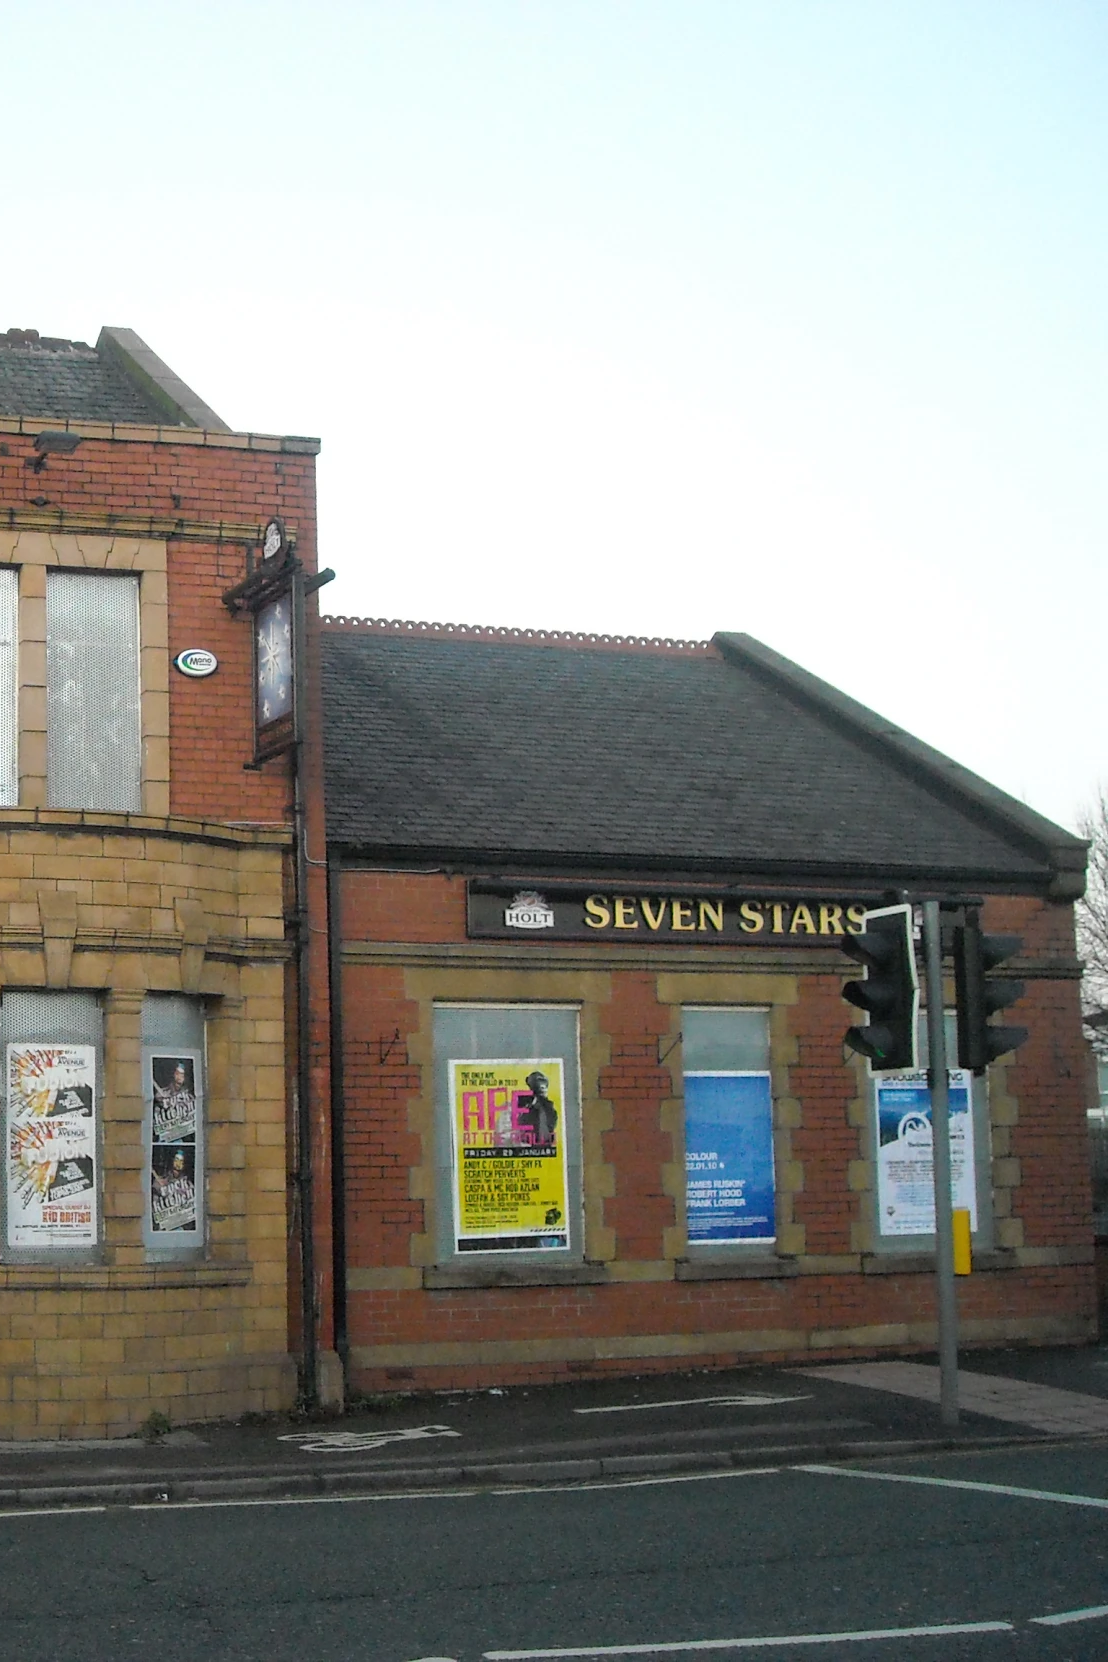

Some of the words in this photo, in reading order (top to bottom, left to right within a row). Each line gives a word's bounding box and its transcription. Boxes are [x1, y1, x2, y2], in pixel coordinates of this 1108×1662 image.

[509, 913, 551, 924] HOLT
[584, 895, 724, 932] SEVEN
[739, 900, 868, 935] STARS
[462, 1087, 534, 1131] APE
[463, 1132, 478, 1146] AT
[464, 1149, 497, 1157] FRIDAY
[519, 1147, 556, 1156] JANUARY
[464, 1160, 480, 1169] ANDY
[481, 1160, 487, 1169] C
[492, 1160, 514, 1169] GOLDIE
[521, 1160, 533, 1169] SHY
[464, 1170, 493, 1179] SCRATCH
[464, 1184, 485, 1193] CASPA
[494, 1184, 504, 1193] MC
[718, 1189, 742, 1198] HOOD
[687, 1199, 712, 1207] FRANK
